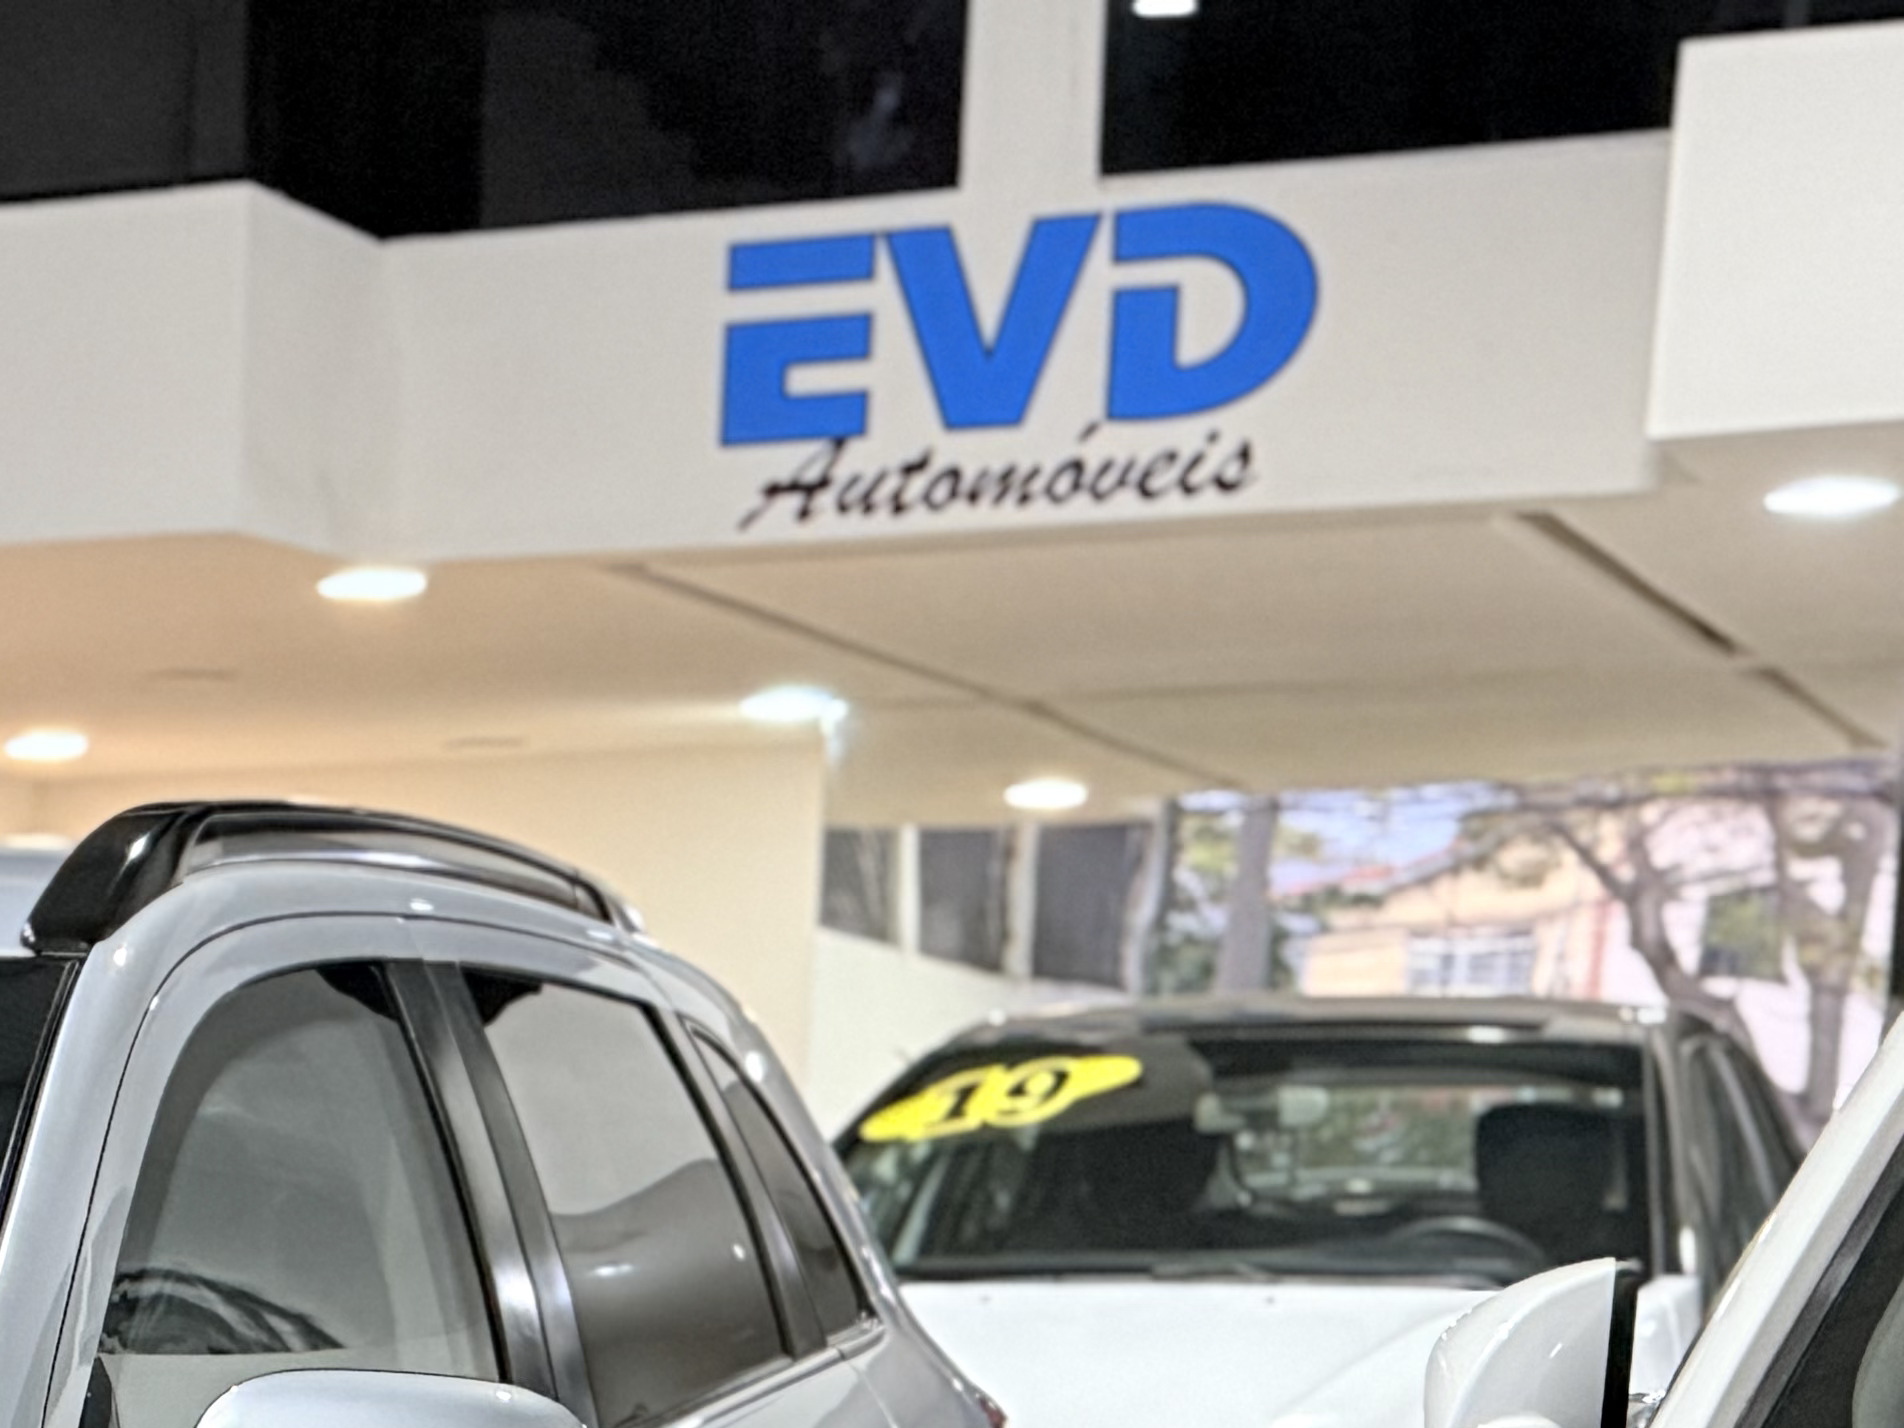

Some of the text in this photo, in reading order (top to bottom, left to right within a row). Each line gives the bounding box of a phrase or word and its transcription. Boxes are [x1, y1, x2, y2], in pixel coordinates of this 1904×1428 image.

[720, 200, 1320, 446] EVD
[737, 420, 1256, 530] Automóveis
[922, 1064, 1074, 1124] 19
